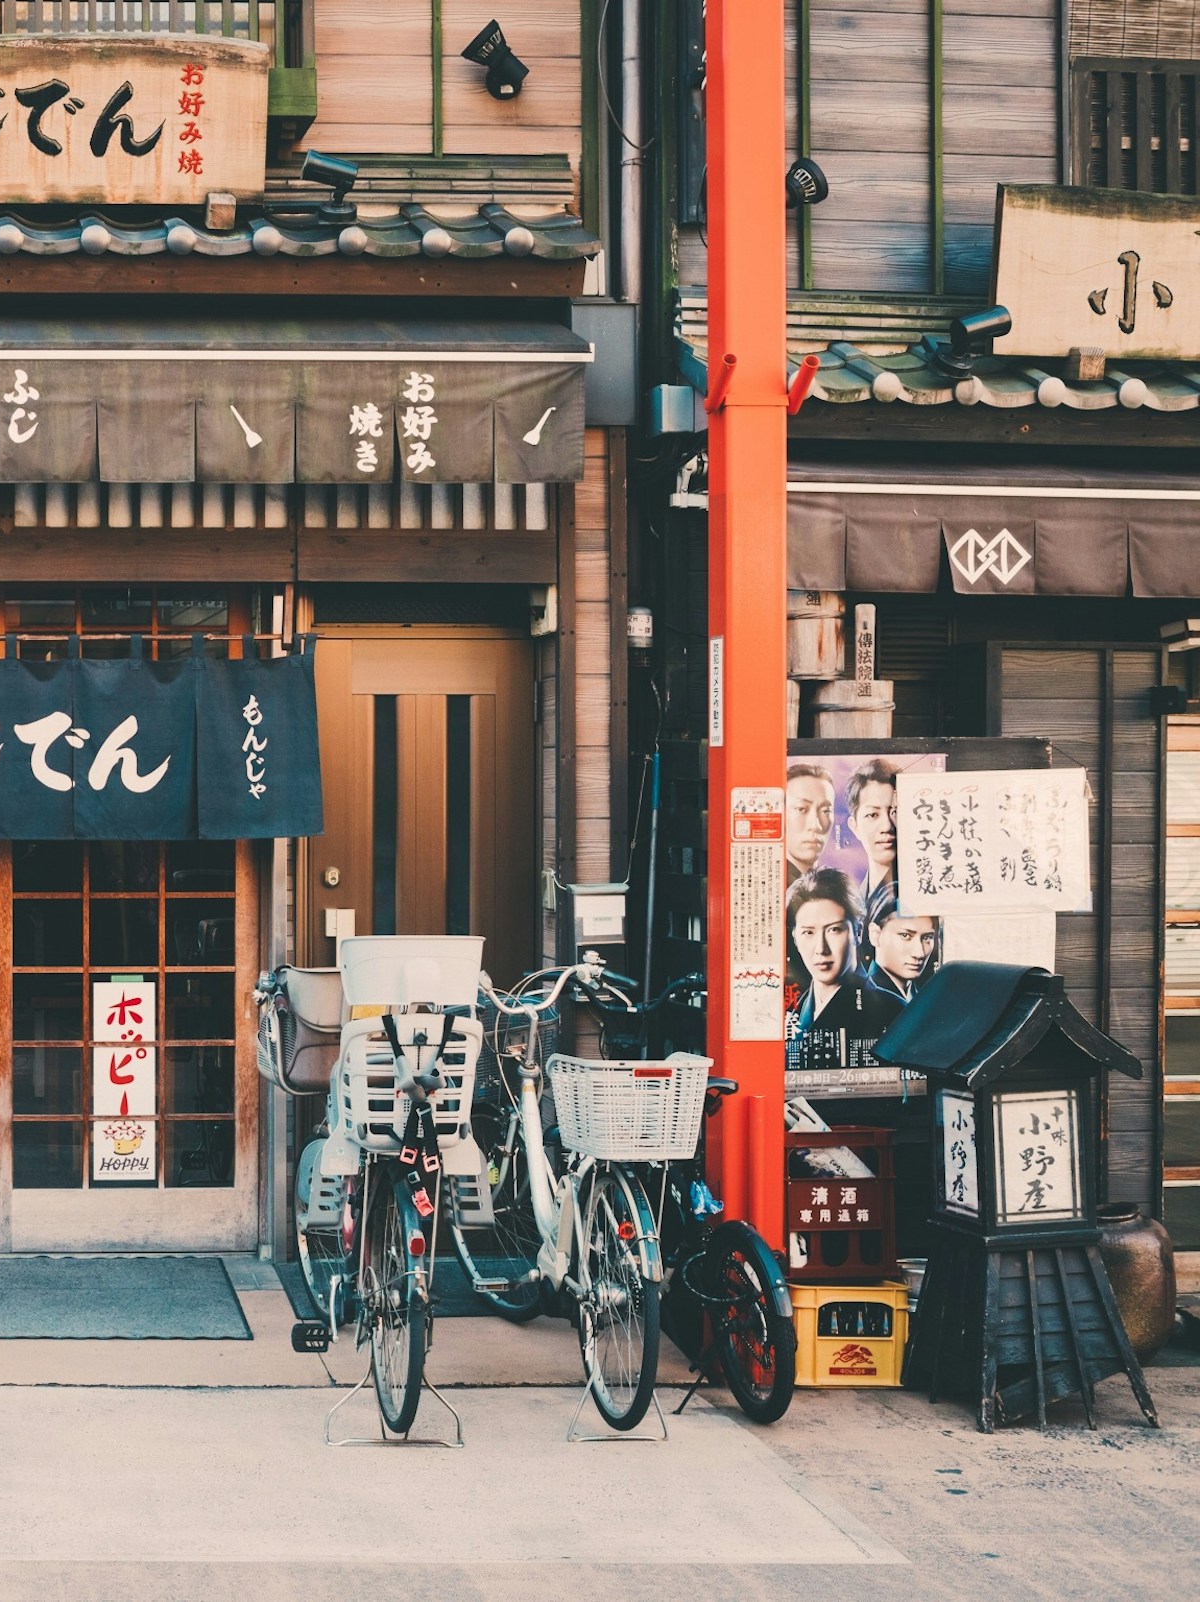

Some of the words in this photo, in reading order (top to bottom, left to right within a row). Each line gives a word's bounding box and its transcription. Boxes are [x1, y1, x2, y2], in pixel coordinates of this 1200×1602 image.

[177, 63, 205, 176] お好み焼
[3, 369, 40, 444] ふじ
[348, 402, 384, 473] 焼き
[401, 371, 437, 474] お好み
[242, 694, 268, 800] もんじゃ
[106, 991, 147, 1116] ホッピー
[811, 1187, 857, 1206] 清酒
[950, 1109, 968, 1202] 小野屋
[1018, 1113, 1055, 1212] 小野屋
[800, 1209, 870, 1223] 専用通箱
